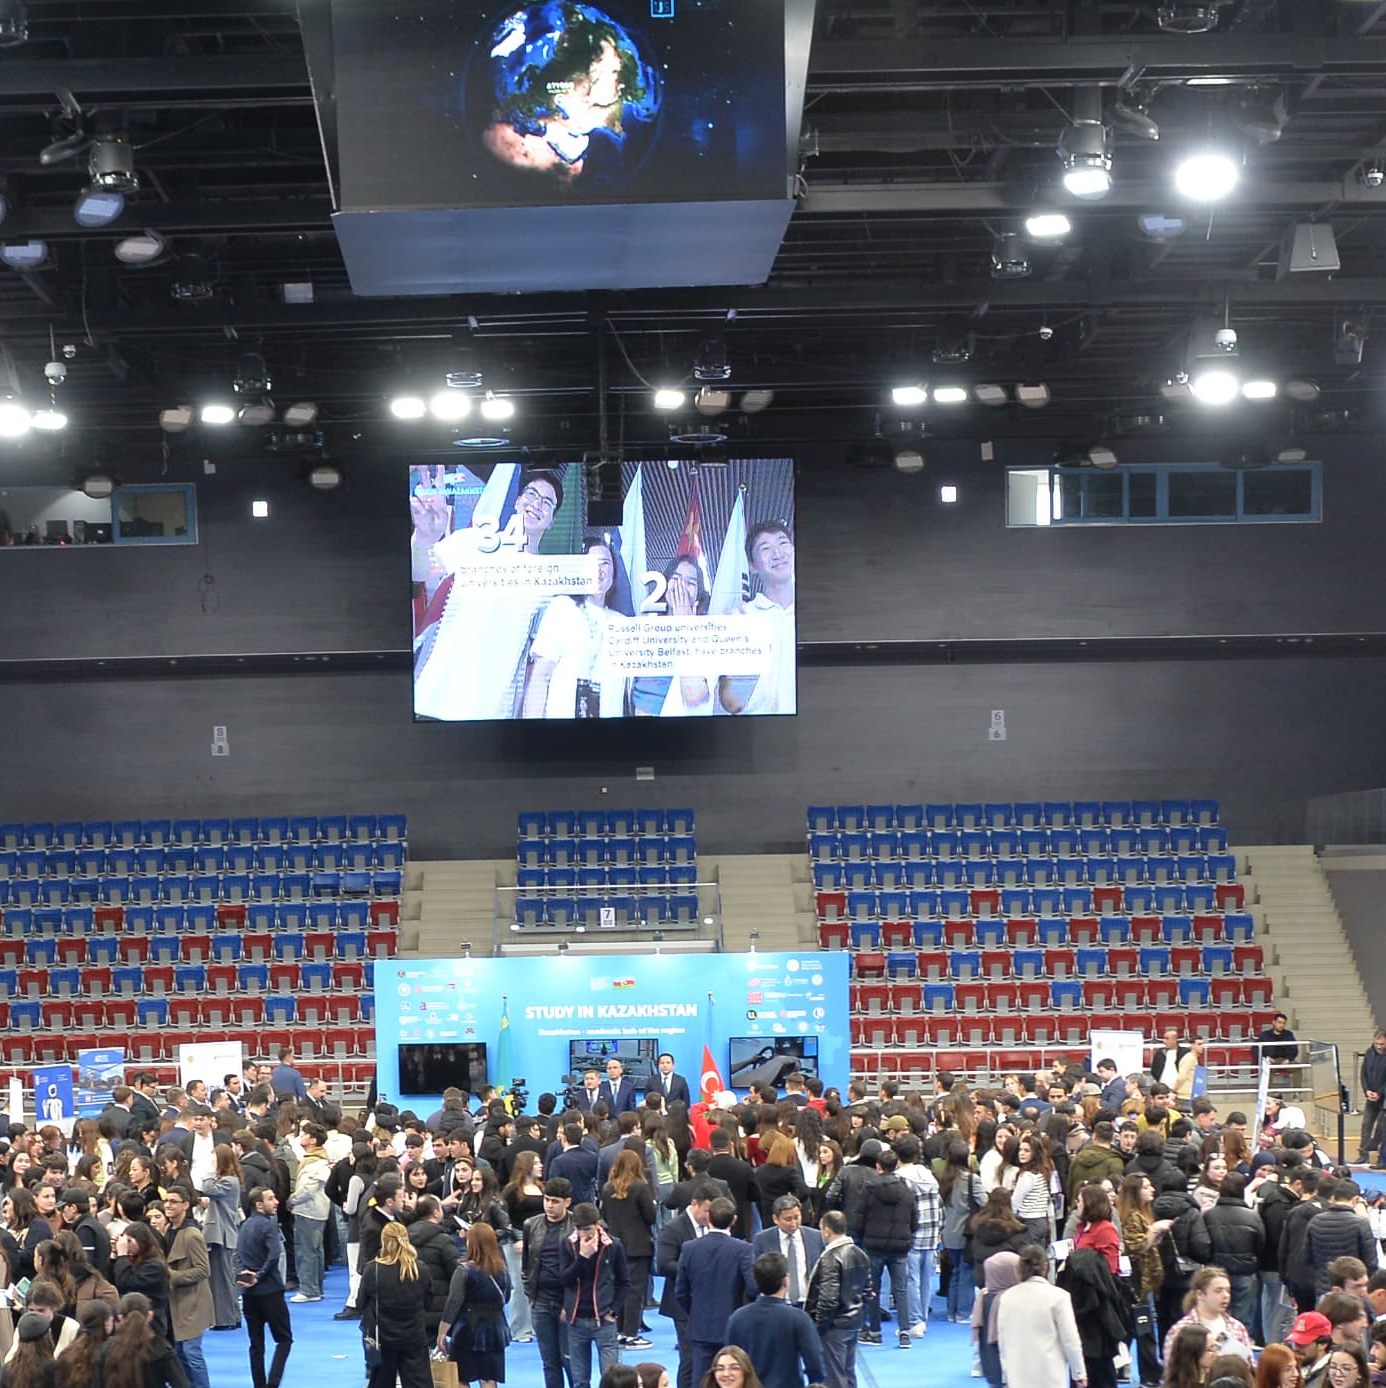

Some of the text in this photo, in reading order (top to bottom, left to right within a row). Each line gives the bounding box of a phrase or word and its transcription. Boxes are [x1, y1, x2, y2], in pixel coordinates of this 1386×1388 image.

[474, 512, 530, 554] 34
[534, 576, 594, 588] Kazakhstan
[640, 570, 669, 614] 2
[643, 621, 673, 634] Group
[643, 634, 688, 646] University
[607, 647, 655, 659] University
[525, 1003, 698, 1019] STUDY IN KAZAKHSTAN
